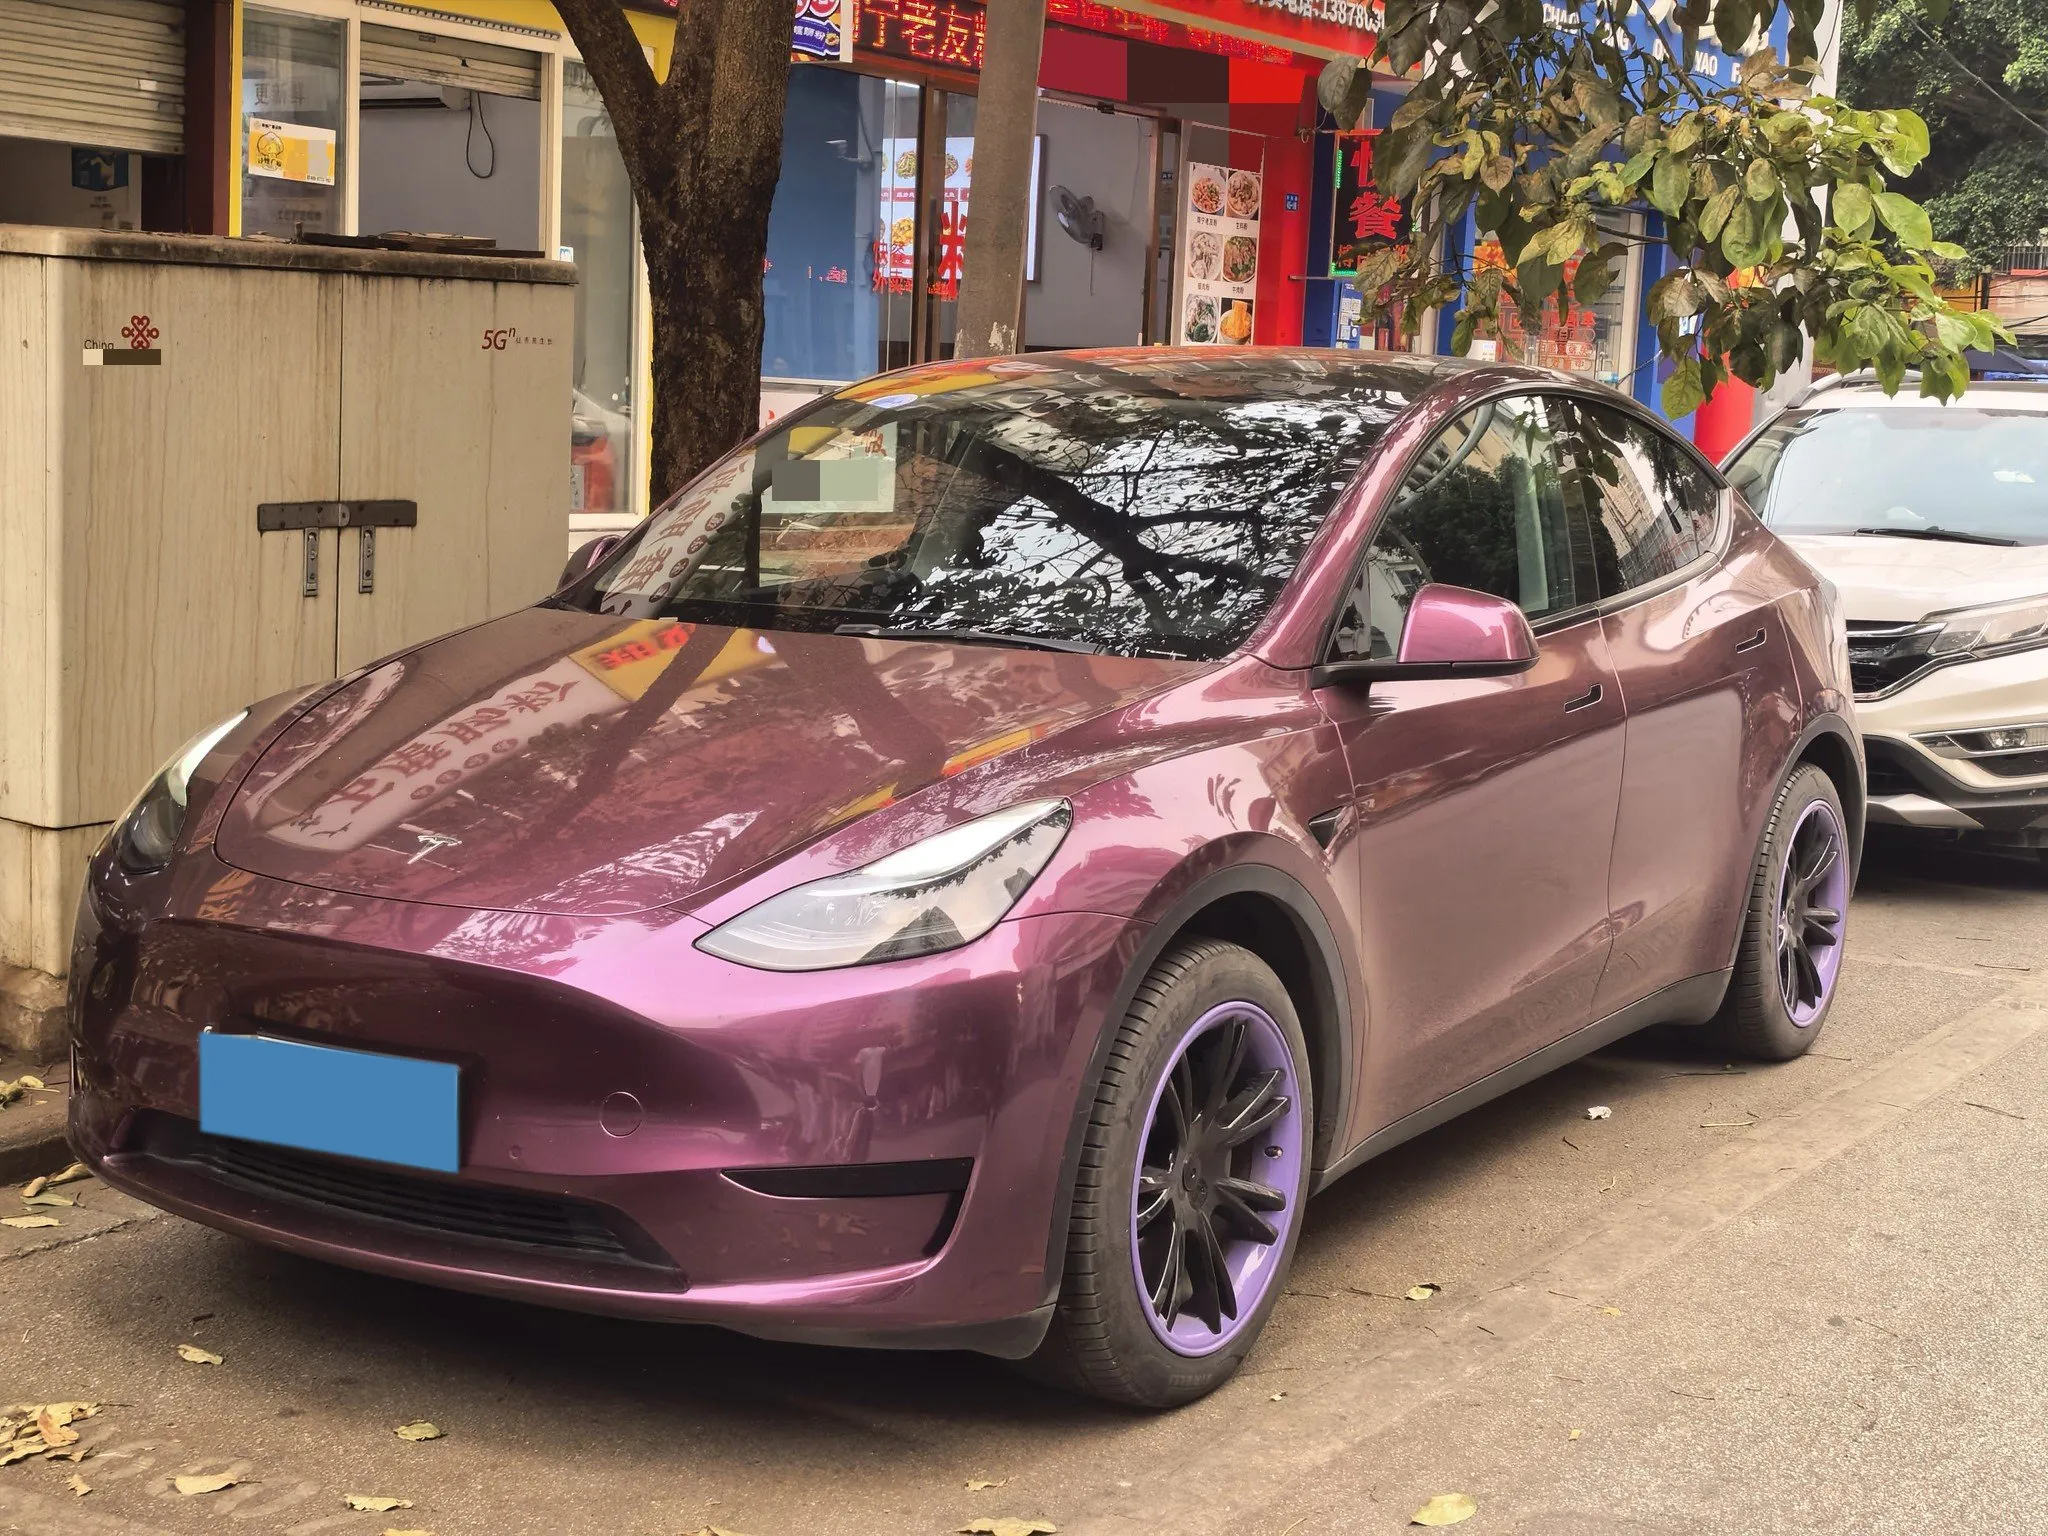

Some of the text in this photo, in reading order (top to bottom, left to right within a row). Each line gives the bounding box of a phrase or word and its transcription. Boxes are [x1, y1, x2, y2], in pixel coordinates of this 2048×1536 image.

[852, 0, 987, 68] 宁老友
[1695, 50, 1718, 77] YAO
